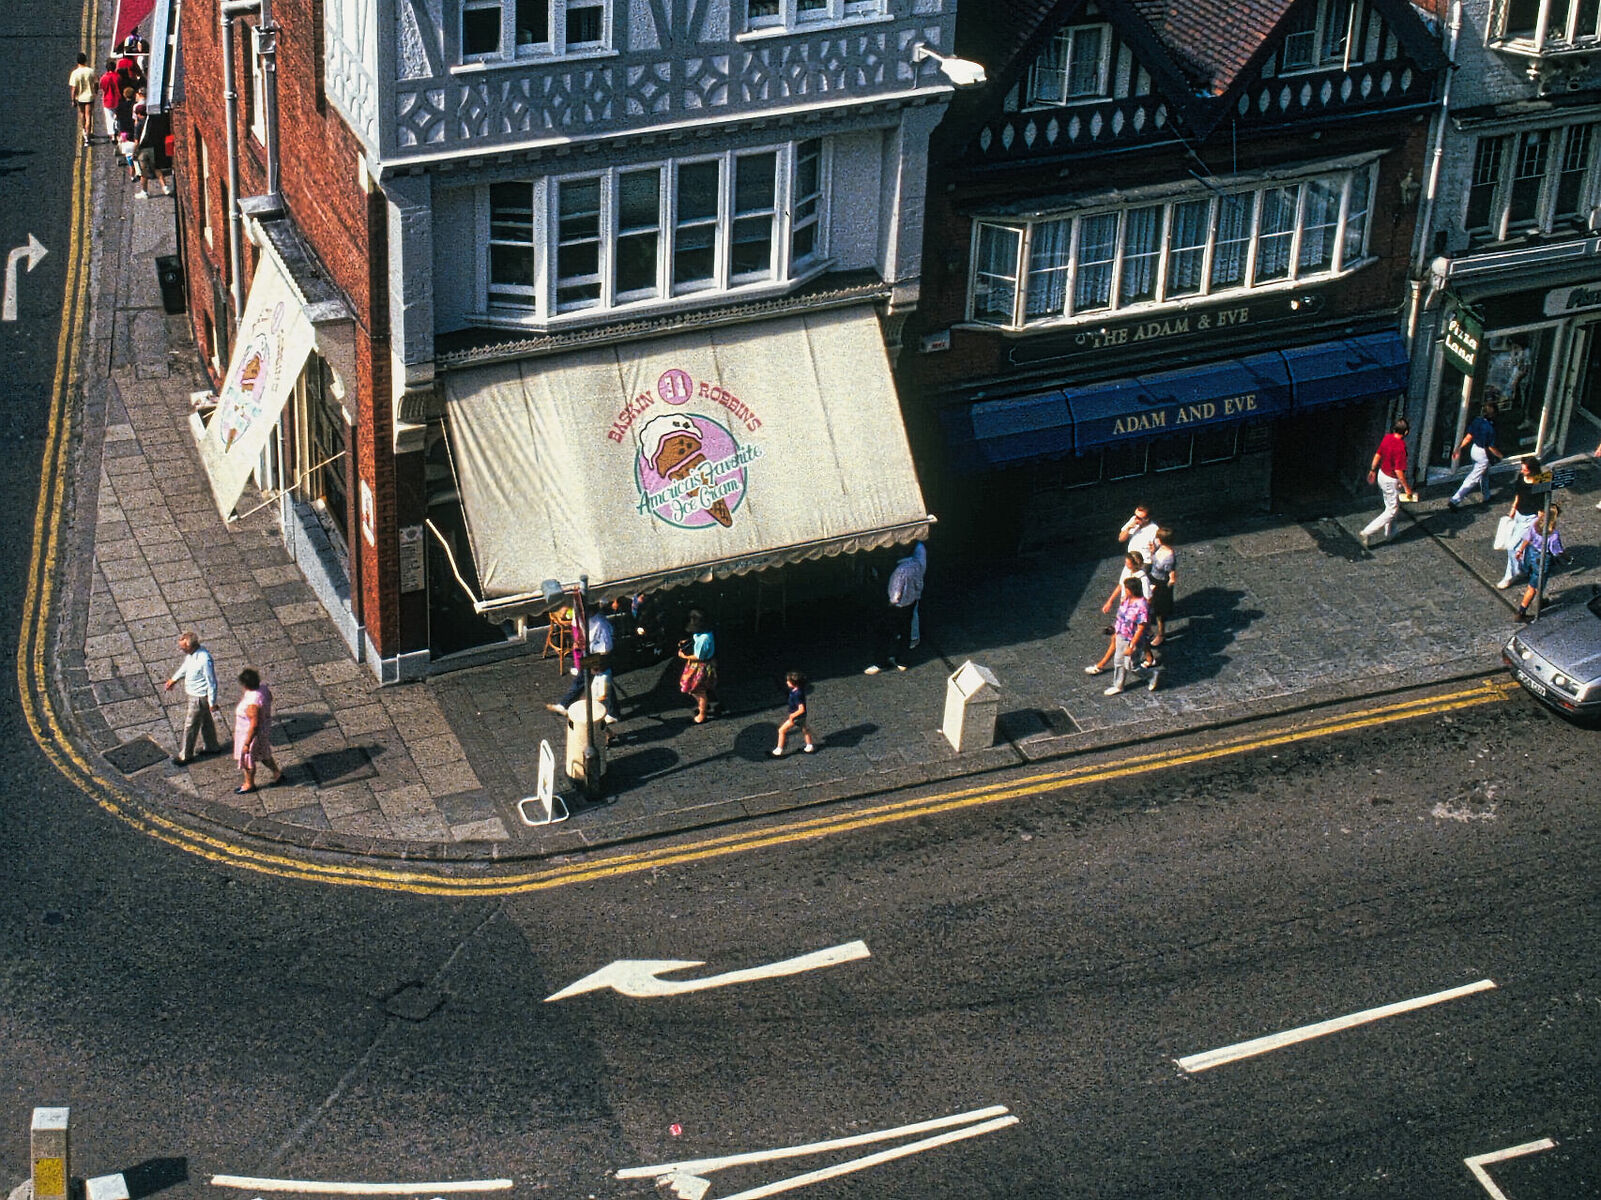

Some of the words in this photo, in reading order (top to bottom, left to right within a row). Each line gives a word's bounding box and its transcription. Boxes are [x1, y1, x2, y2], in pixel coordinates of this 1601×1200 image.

[1133, 318, 1190, 341] ADAM
[1198, 314, 1211, 329] &
[1216, 308, 1249, 326] EVE
[1445, 334, 1475, 365] Land
[608, 390, 655, 443] BASKIN
[664, 375, 688, 399] 31
[698, 381, 762, 432] ROBBINS
[1112, 410, 1166, 435] ADAM
[1176, 402, 1215, 424] AND
[1224, 395, 1257, 415] EVE
[697, 444, 762, 484] Favorite
[672, 498, 698, 522] Ice
[700, 479, 739, 508] Cream
